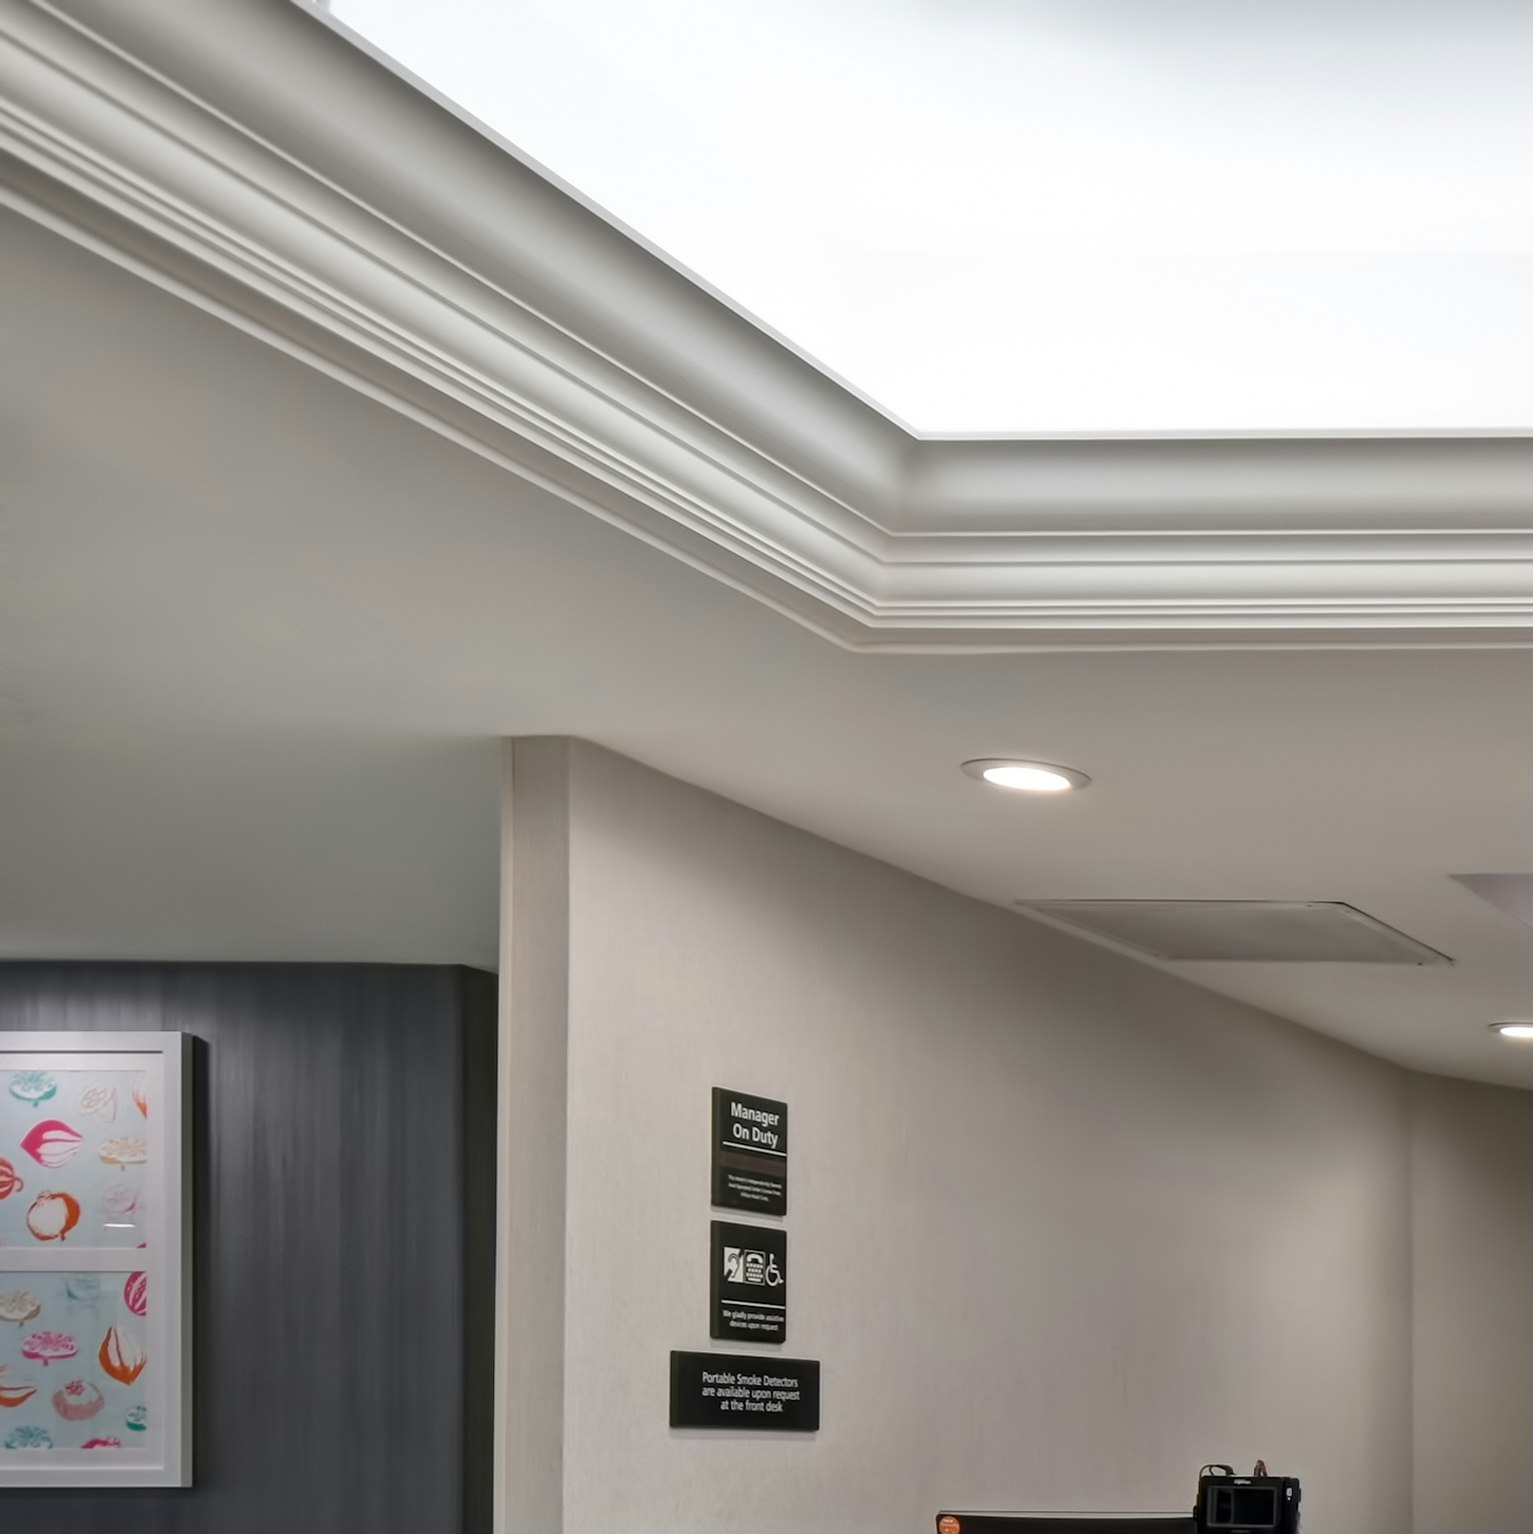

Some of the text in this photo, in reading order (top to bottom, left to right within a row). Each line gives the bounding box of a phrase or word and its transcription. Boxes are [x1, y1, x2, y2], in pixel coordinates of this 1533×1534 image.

[730, 1101, 780, 1127] Manager
[732, 1123, 779, 1149] On Duty
[702, 1371, 798, 1388] Portable Smoke Detectors
[702, 1386, 800, 1402] are available upon request
[720, 1399, 783, 1412] at the front desk
